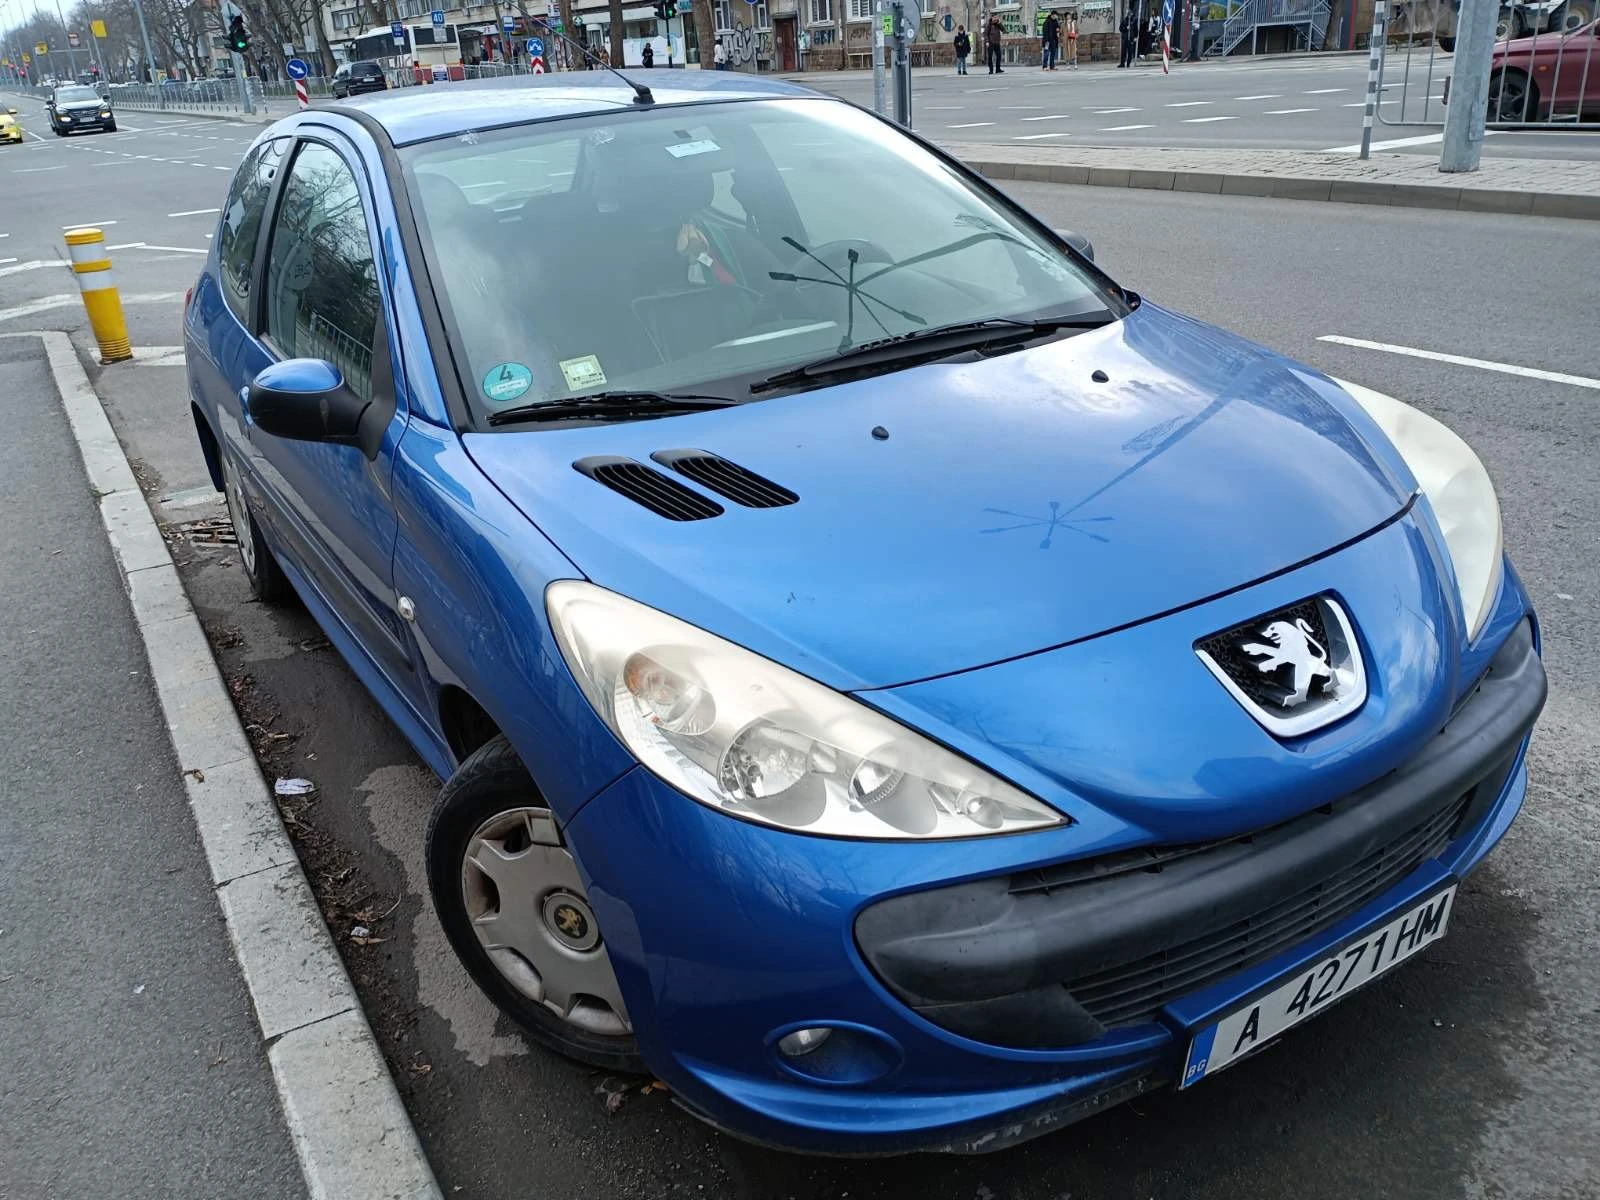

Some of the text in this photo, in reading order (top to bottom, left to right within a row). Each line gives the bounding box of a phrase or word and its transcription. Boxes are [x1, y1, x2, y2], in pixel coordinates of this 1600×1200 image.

[433, 13, 443, 22] 40
[499, 365, 513, 381] 4
[1232, 1006, 1260, 1053] A
[1187, 1059, 1206, 1079] BG
